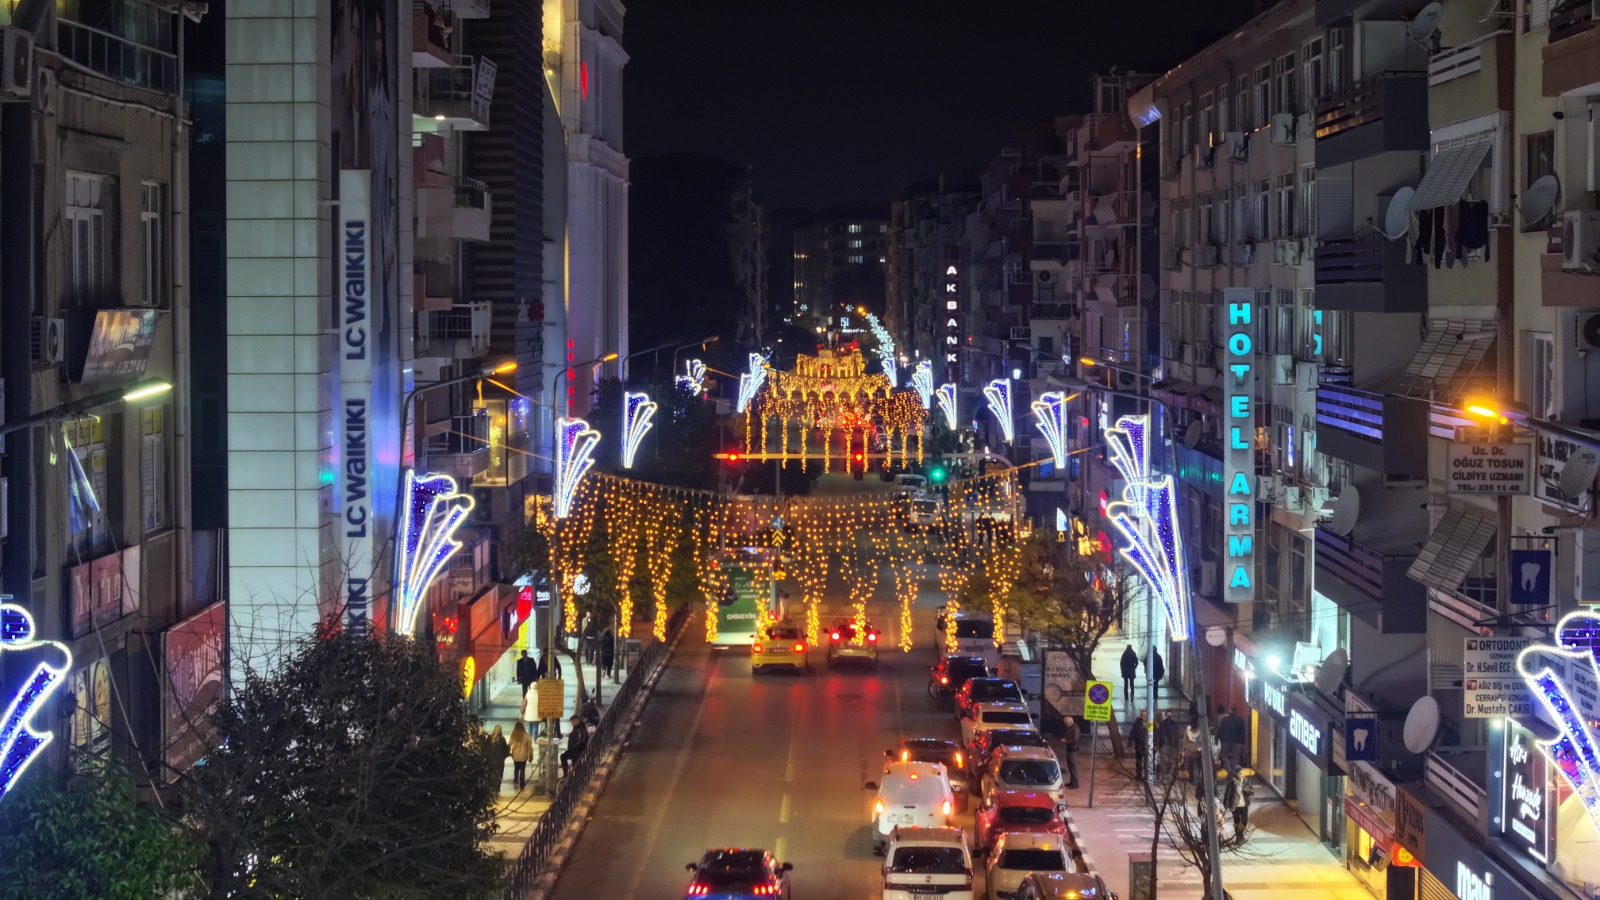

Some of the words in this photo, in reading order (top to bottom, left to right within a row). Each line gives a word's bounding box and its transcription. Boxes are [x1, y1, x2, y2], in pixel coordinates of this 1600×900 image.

[946, 265, 958, 363] AKBANK
[1228, 303, 1252, 450] HOTEL
[1472, 445, 1489, 455] Uz.
[1491, 445, 1506, 455] Dr.
[1453, 457, 1484, 469] OĞUZ
[1488, 458, 1524, 469] TOSUN
[1452, 470, 1487, 481] CİLDİYE
[1489, 472, 1524, 481] UZMANI
[1228, 472, 1252, 588] ARMA
[1466, 662, 1476, 673] Dr.
[1499, 662, 1511, 673] ECE
[1478, 680, 1492, 690] AĞIZ
[1493, 680, 1503, 692] DİŞ
[1466, 703, 1477, 714] Dr.
[1478, 703, 1507, 714] Mustafa
[1508, 703, 1531, 717] ÇAKIR
[1457, 860, 1494, 900] mavi
